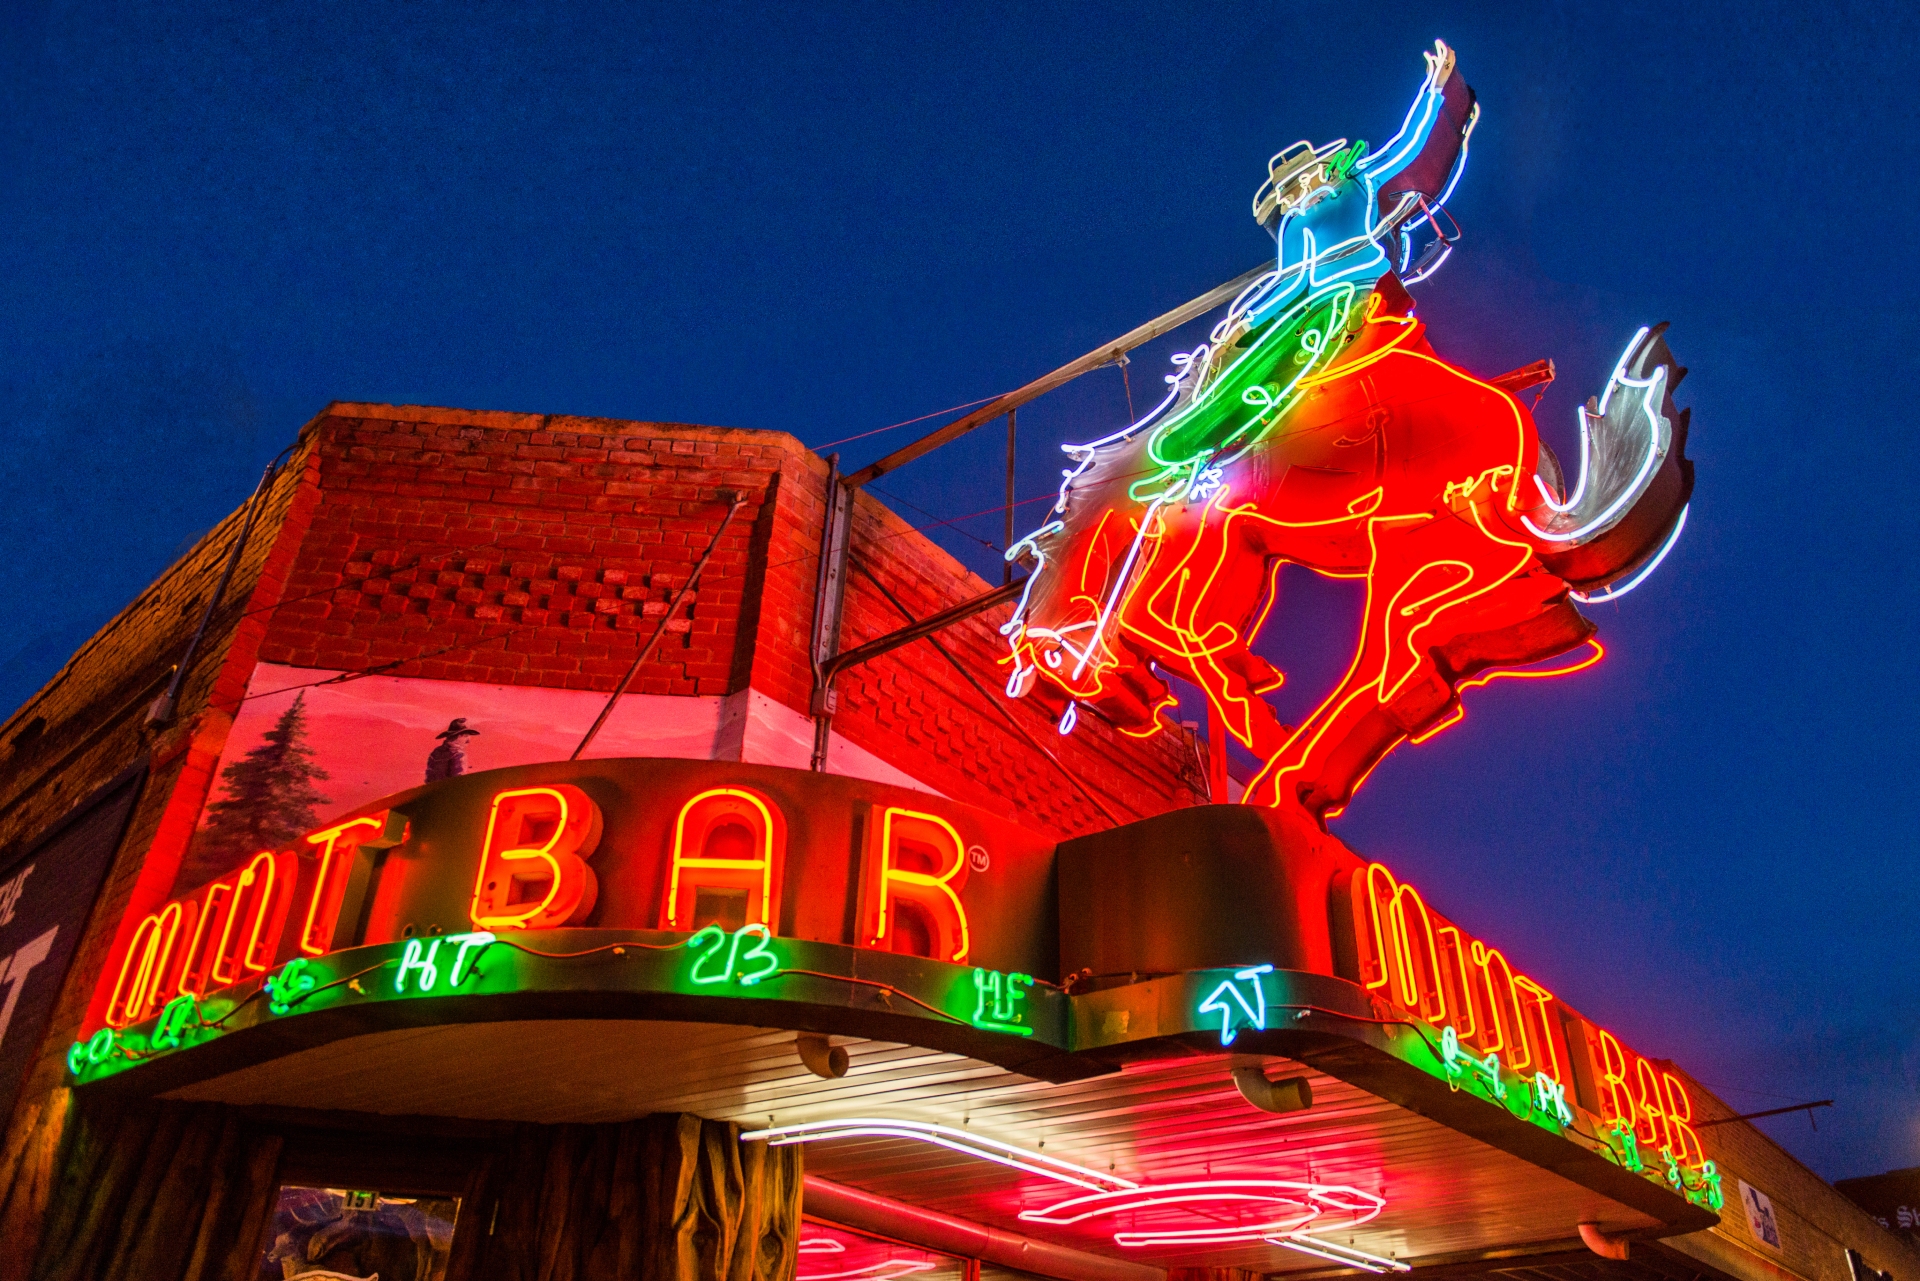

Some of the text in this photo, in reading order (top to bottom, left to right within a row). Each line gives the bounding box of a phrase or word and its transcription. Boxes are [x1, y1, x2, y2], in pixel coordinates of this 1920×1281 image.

[106, 783, 970, 1029] MINT BAR
[969, 848, 988, 869] TM
[1353, 861, 1706, 1172] MINT BAR
